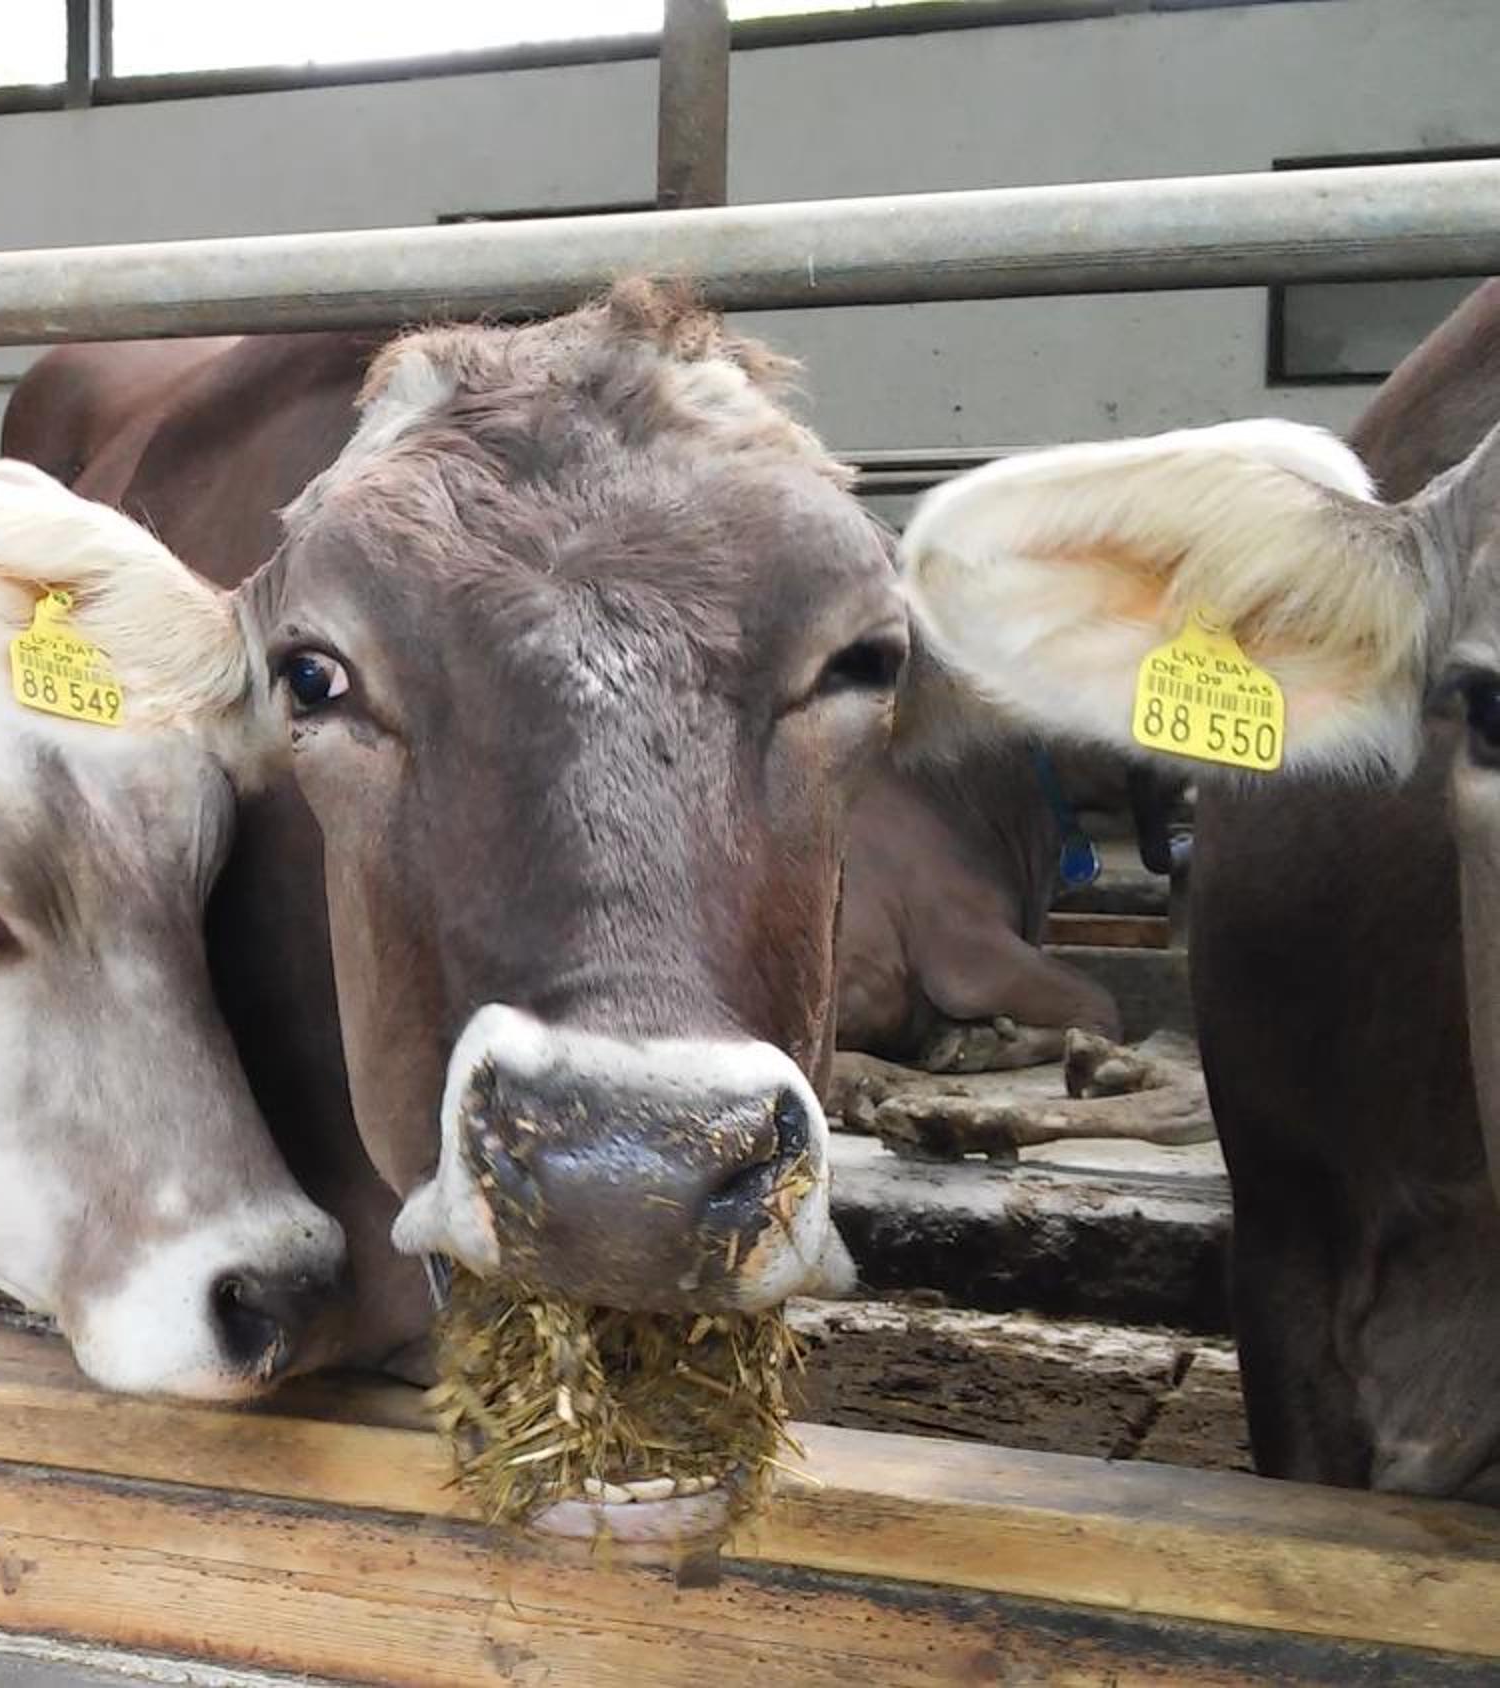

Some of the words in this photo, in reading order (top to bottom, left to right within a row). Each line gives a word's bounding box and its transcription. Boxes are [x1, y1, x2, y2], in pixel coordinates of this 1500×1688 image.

[1151, 658, 1184, 679] DE
[1171, 647, 1206, 668] LKV
[1215, 659, 1252, 677] BAY
[23, 669, 58, 704] 88
[69, 682, 120, 719] 549
[1144, 698, 1190, 742] 88
[1207, 714, 1276, 762] 550
